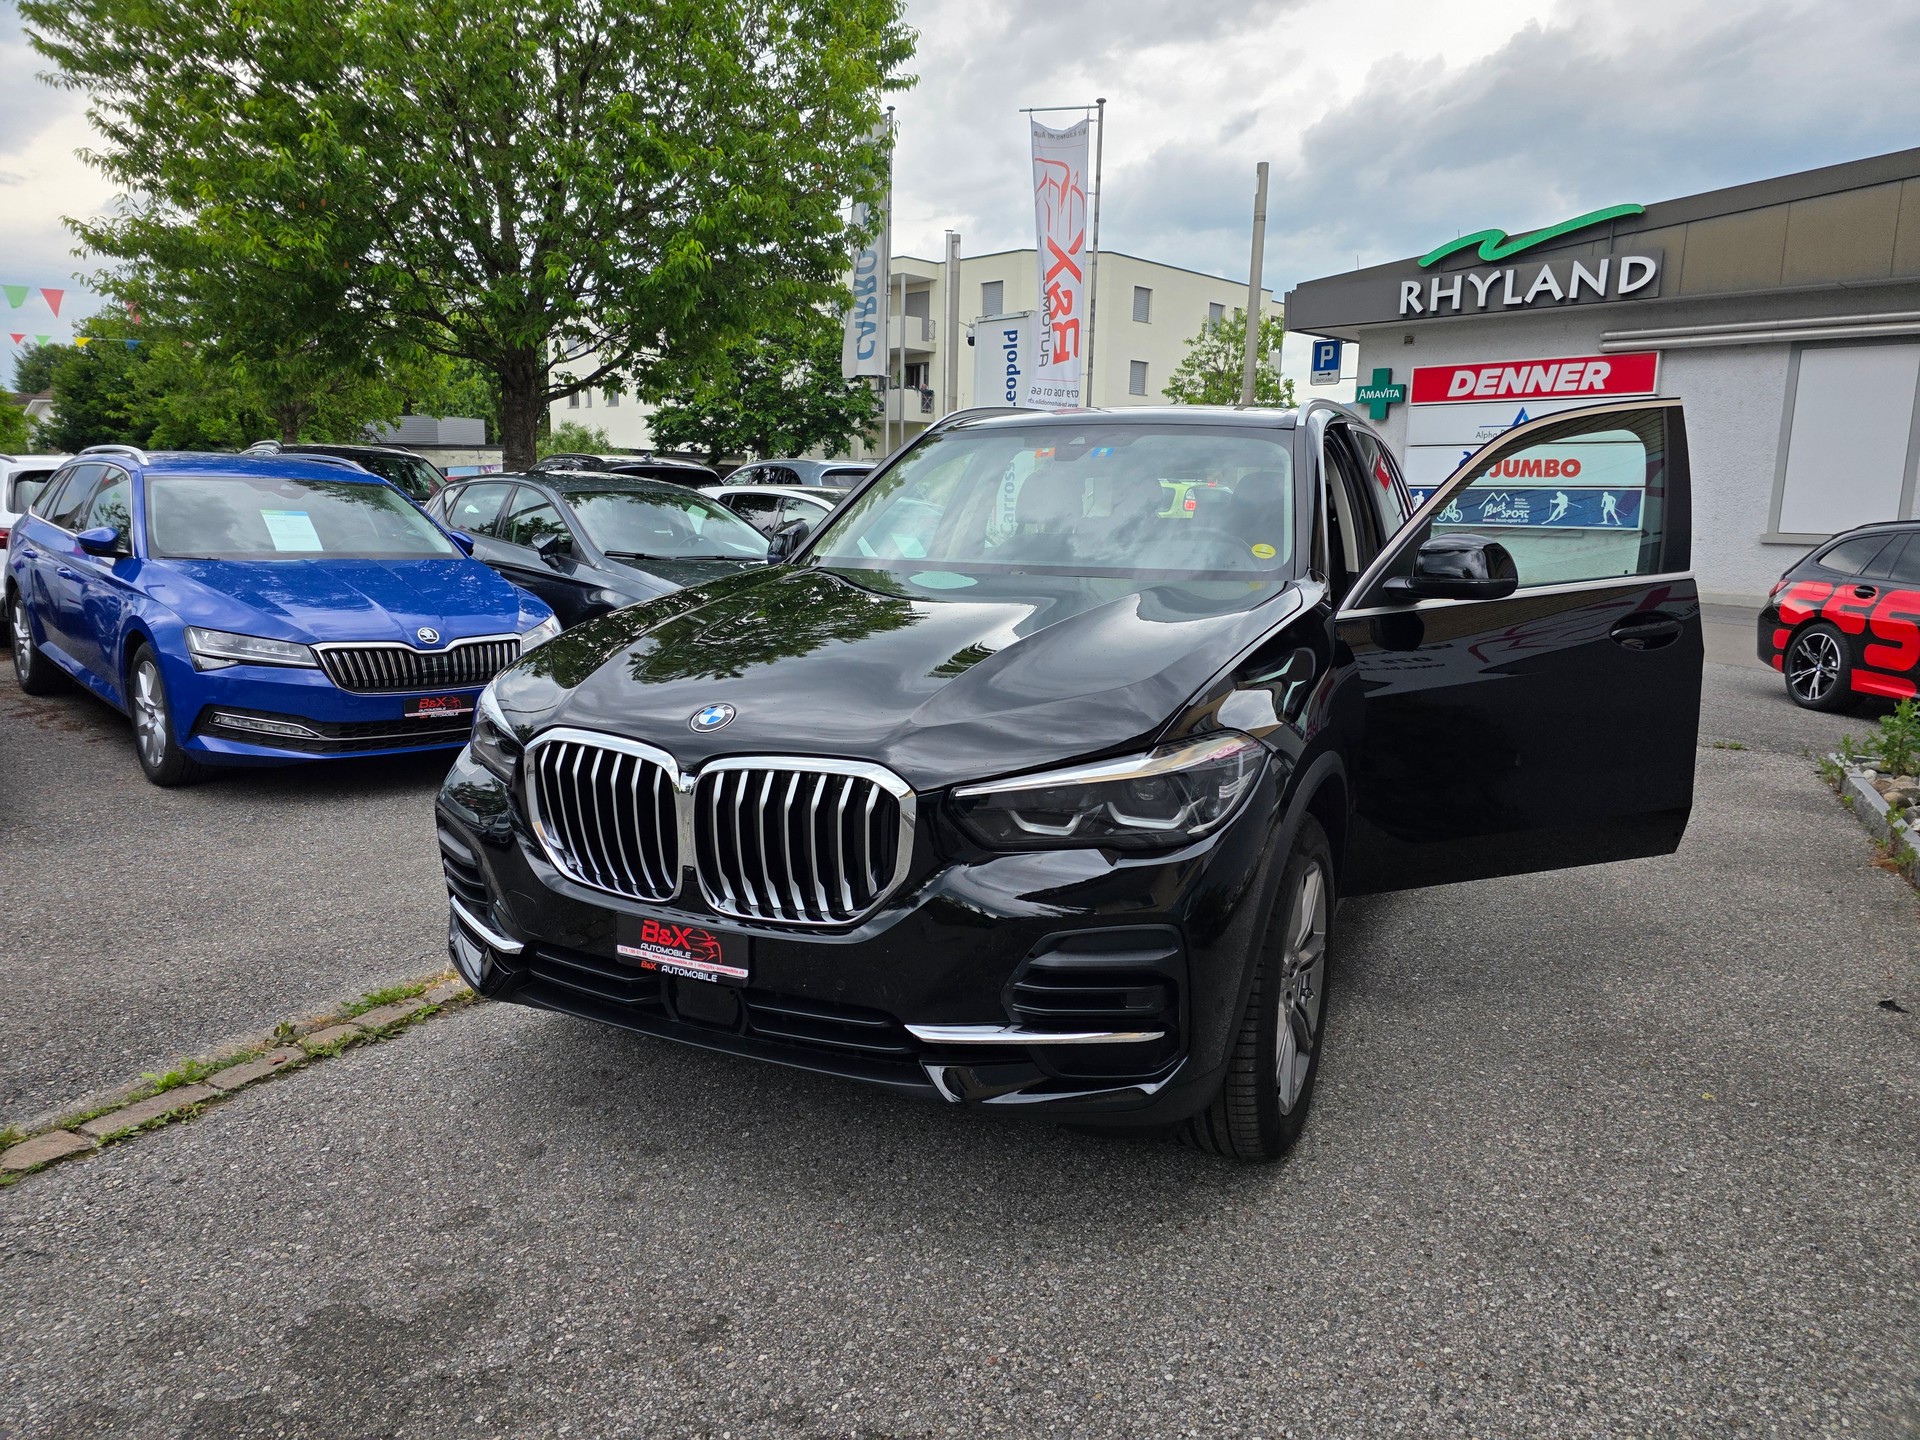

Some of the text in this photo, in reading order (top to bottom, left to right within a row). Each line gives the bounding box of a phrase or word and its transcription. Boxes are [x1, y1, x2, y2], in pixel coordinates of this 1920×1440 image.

[1399, 255, 1657, 315] RHYLAND
[1003, 329, 1021, 406] eopold
[1320, 345, 1334, 368] P
[1447, 361, 1611, 397] DENNER
[1489, 458, 1582, 478] JUMBO
[1000, 460, 1016, 534] Carross
[1500, 510, 1530, 518] SPORT
[419, 697, 447, 708] B&X
[641, 919, 693, 950] B&X
[640, 943, 692, 959] AUTOMOBILE
[640, 960, 718, 982] B&X AUTOMOBILE
